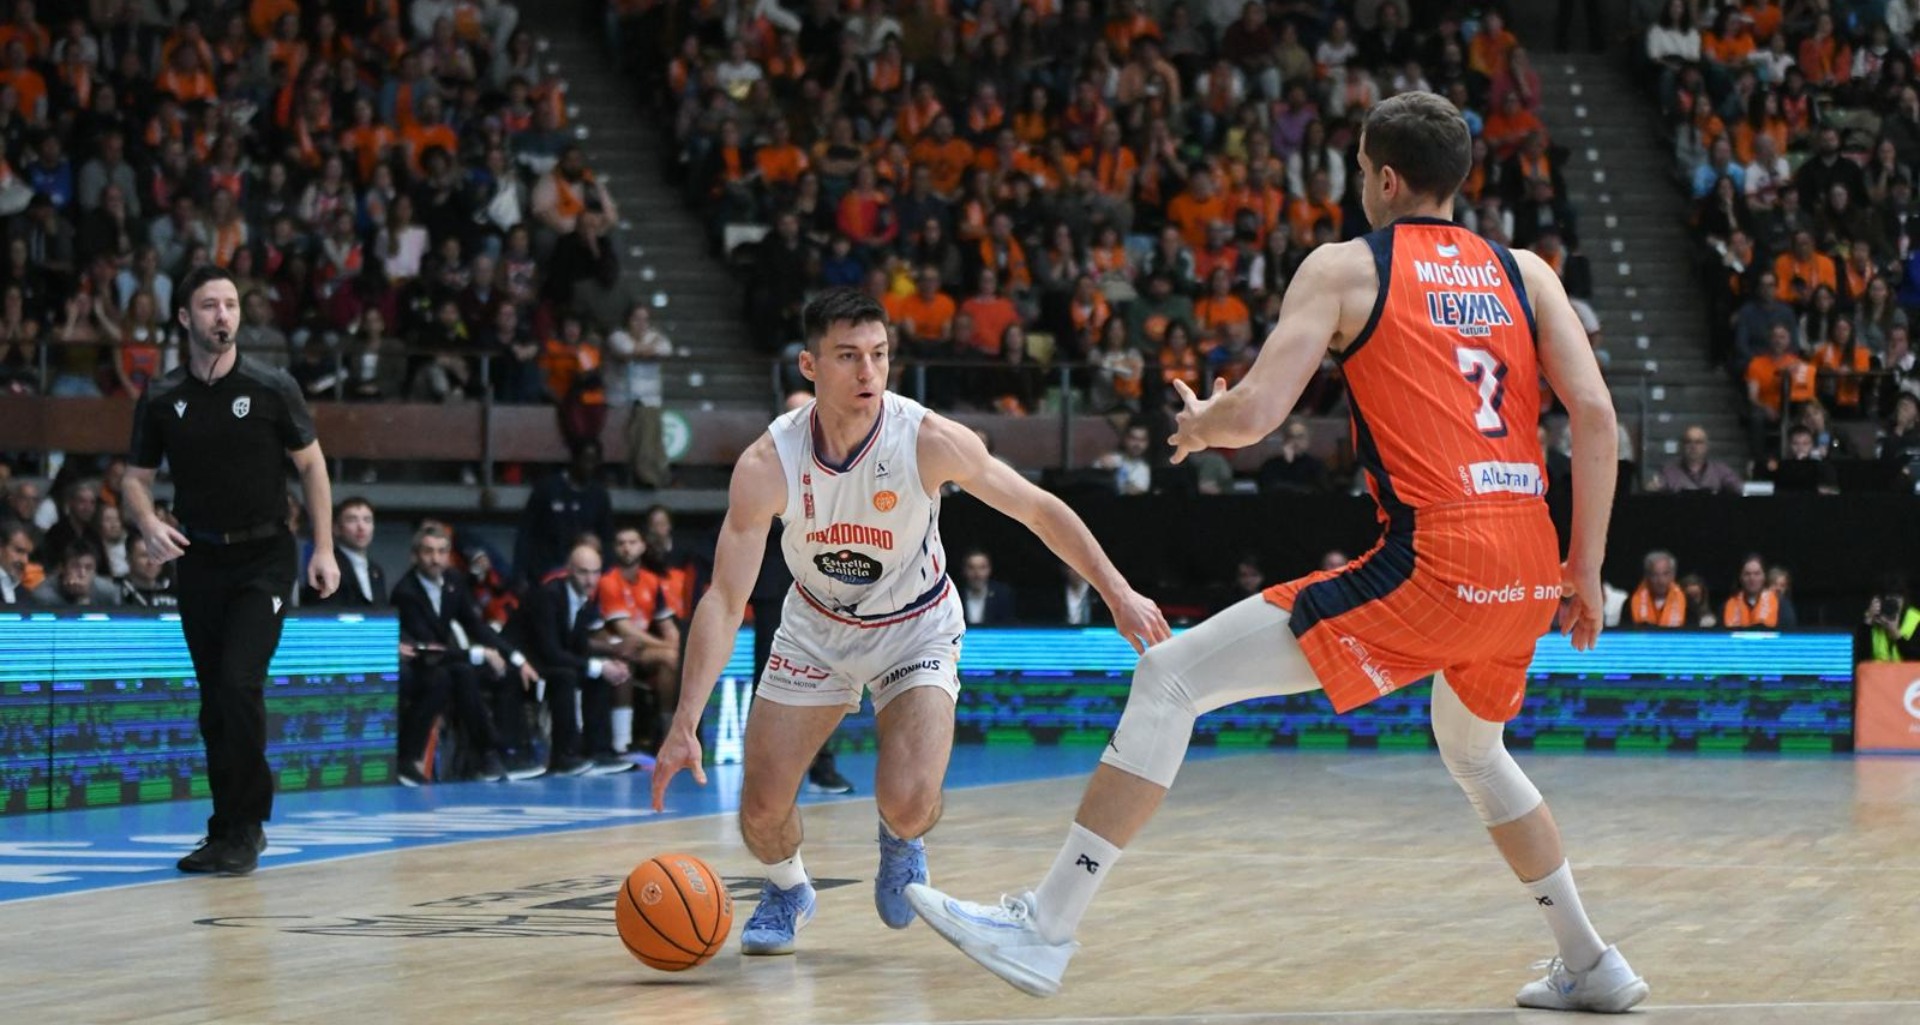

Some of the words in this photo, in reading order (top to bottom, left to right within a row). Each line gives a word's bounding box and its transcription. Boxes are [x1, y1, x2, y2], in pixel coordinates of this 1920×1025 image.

[1414, 260, 1501, 287] MICÓVIĆ
[1427, 292, 1512, 326] LEYMA
[1455, 347, 1508, 437] 7
[822, 556, 871, 569] Estrella
[824, 564, 870, 577] Galicia
[1457, 580, 1525, 604] Nordés
